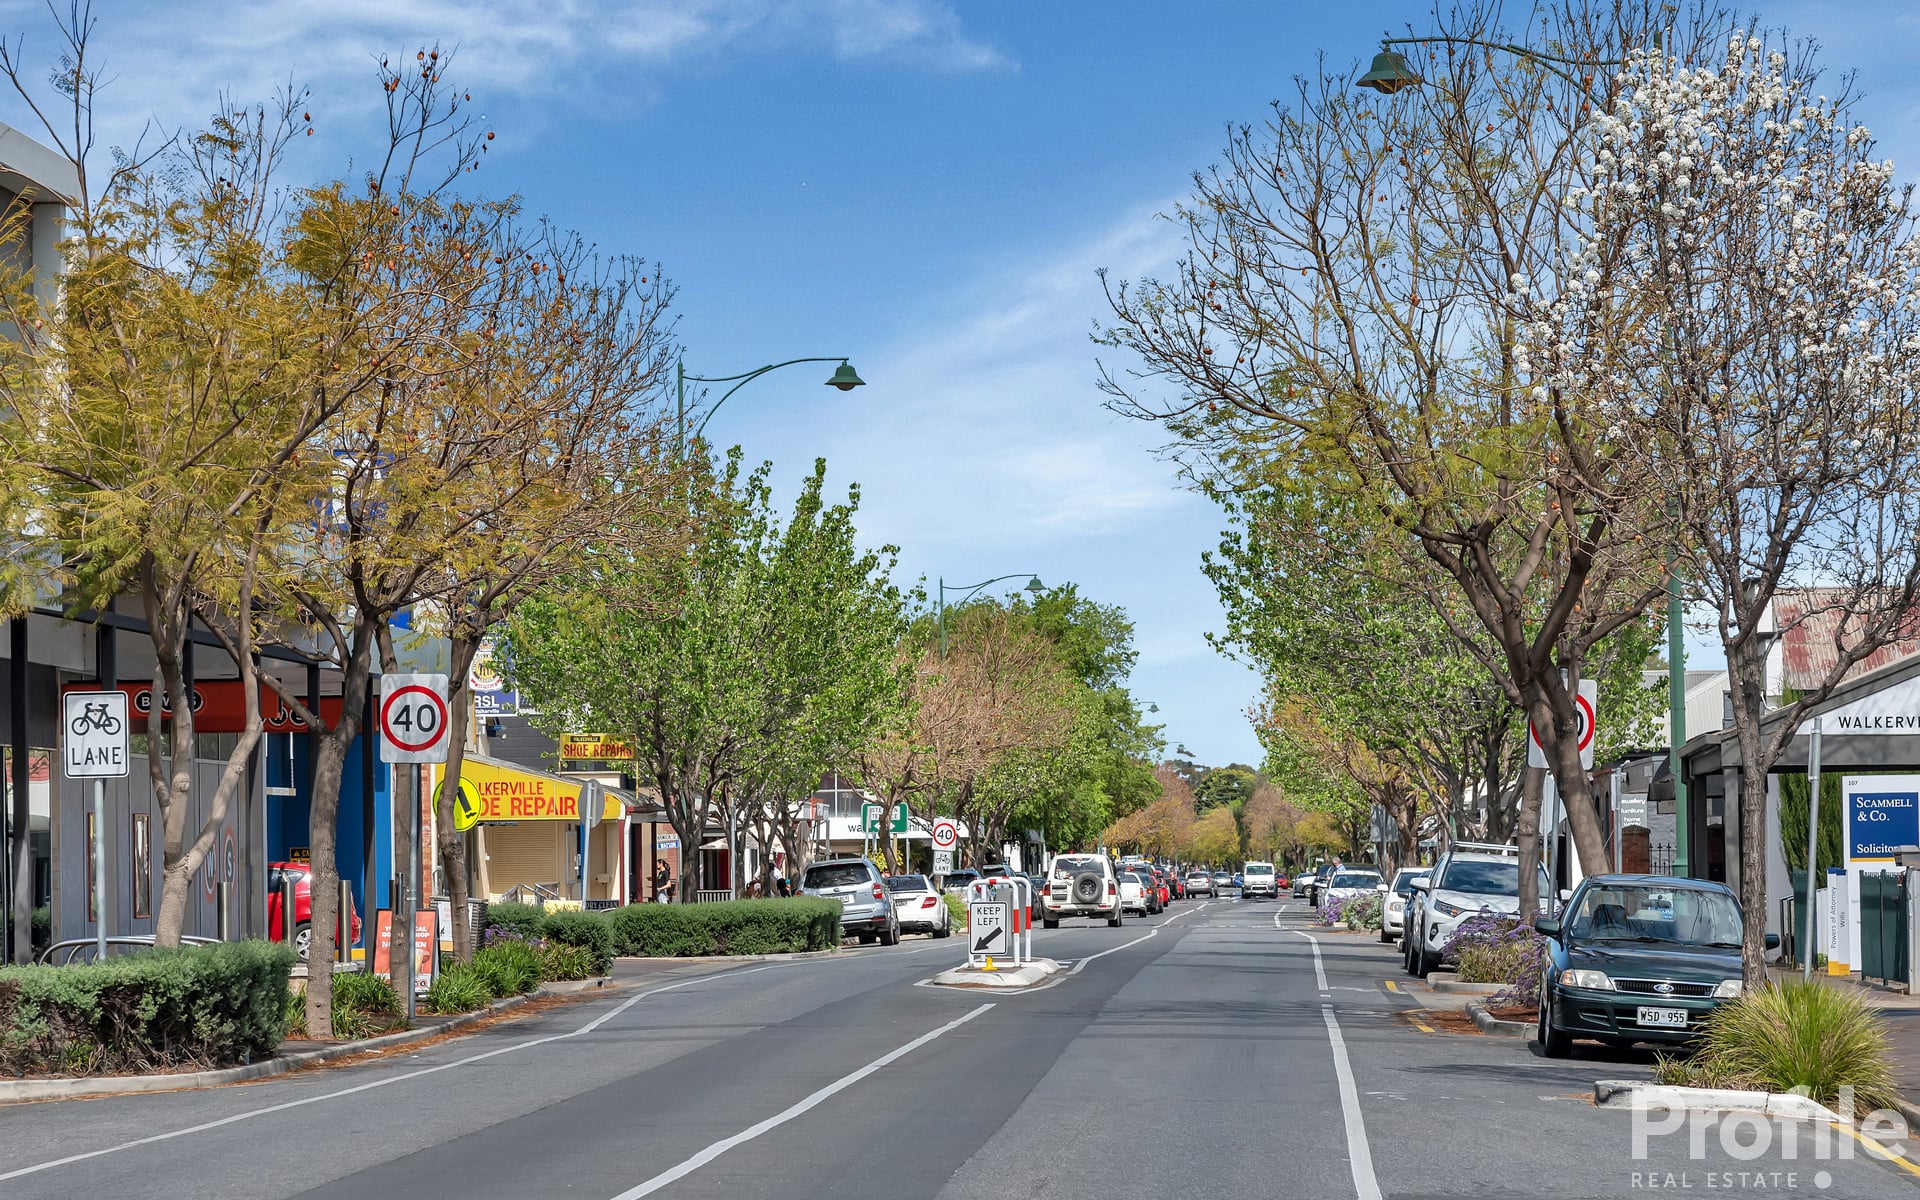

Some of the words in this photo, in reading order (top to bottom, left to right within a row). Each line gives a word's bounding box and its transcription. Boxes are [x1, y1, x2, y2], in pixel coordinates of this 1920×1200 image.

[392, 705, 436, 732] 40
[72, 747, 121, 765] LANE
[564, 744, 588, 757] SHOE
[594, 744, 632, 757] REPAIRS
[478, 782, 544, 796] LKERVILLE
[1620, 798, 1646, 806] ewellery
[1856, 797, 1913, 808] SCAMMELL
[1857, 811, 1867, 822] &
[937, 829, 953, 840] 40
[1856, 843, 1898, 854] Solicitor
[976, 906, 1001, 915] KEEP
[977, 917, 1000, 926] LEFT
[1640, 1011, 1660, 1022] WSD
[1668, 1012, 1685, 1023] 955
